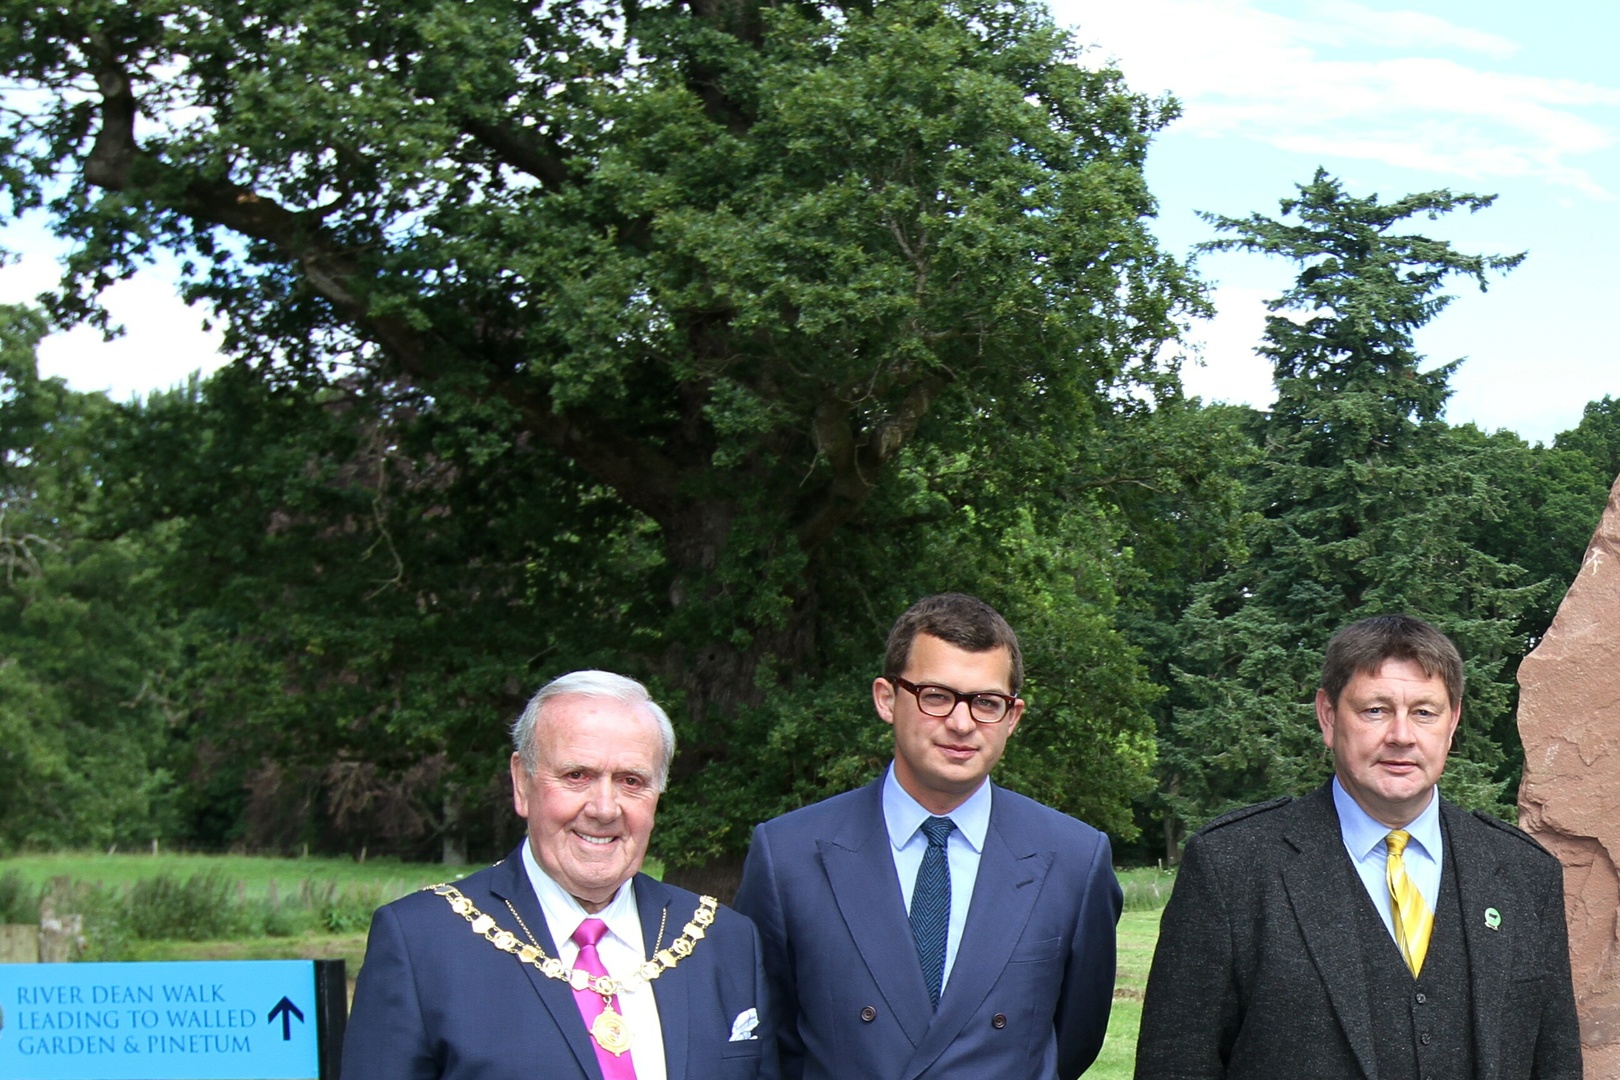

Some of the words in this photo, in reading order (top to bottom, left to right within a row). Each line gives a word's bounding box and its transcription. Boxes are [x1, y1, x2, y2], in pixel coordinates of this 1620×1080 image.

[17, 986, 84, 1005] RIVER
[92, 985, 154, 1003] DEAN
[162, 983, 226, 1002] WALK
[18, 1010, 119, 1030] LEADING
[127, 1009, 159, 1029] TO
[166, 1008, 256, 1028] WALLED
[18, 1035, 115, 1055] GARDEN
[123, 1035, 141, 1054] &
[148, 1034, 252, 1053] PINETUM
